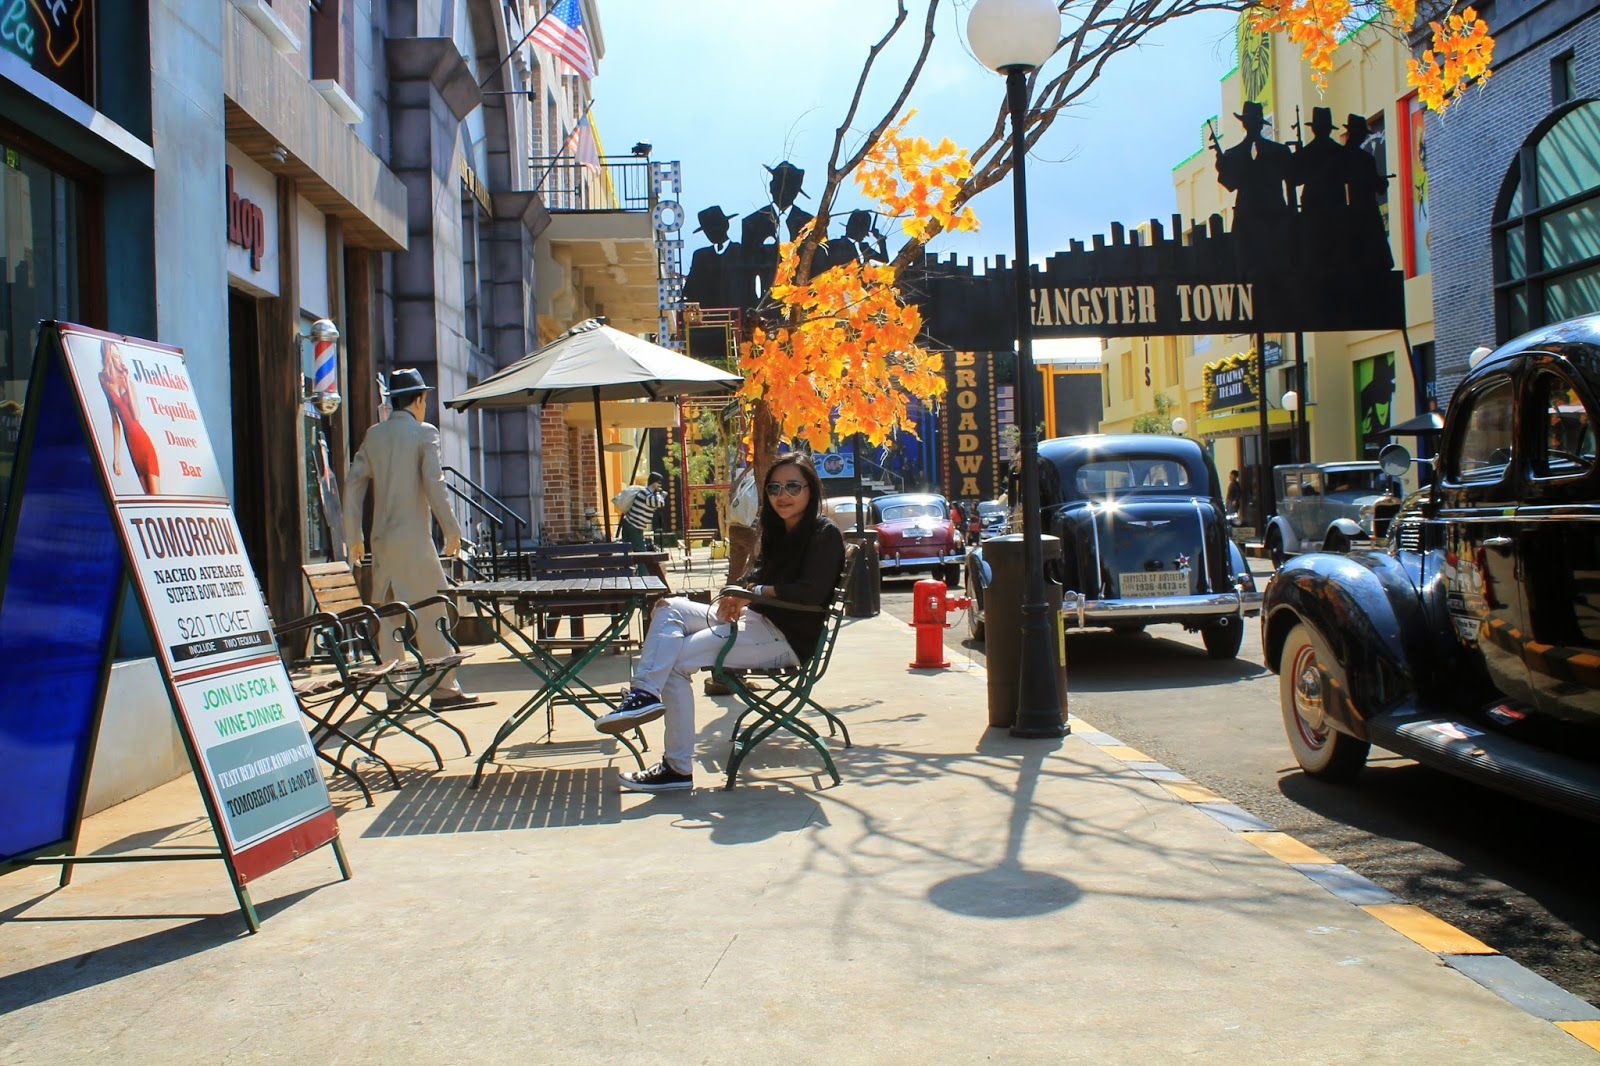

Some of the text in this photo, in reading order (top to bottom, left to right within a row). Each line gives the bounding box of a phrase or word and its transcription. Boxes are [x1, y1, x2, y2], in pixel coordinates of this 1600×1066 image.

[651, 160, 685, 348] HOTEL
[1176, 283, 1254, 322] TOWN
[132, 359, 189, 392] Jhakkas
[147, 396, 198, 422] Tequilla
[165, 430, 198, 449] Dance
[954, 351, 984, 502] BROADWA
[179, 461, 203, 479] Bar
[130, 517, 239, 559] TOMORROW
[154, 564, 245, 584] NACHO AVERAGE
[167, 581, 246, 604] SUPER BOWL PARTY!
[178, 609, 254, 642] $20 TICKET
[189, 641, 217, 655] INCLUDE
[223, 638, 239, 649] TWO
[202, 676, 279, 710] JOIN US FOR A
[214, 703, 286, 738] WINE DINNER
[218, 764, 256, 789] FEATURED
[278, 779, 289, 798] AT
[287, 772, 307, 794] 12:00
